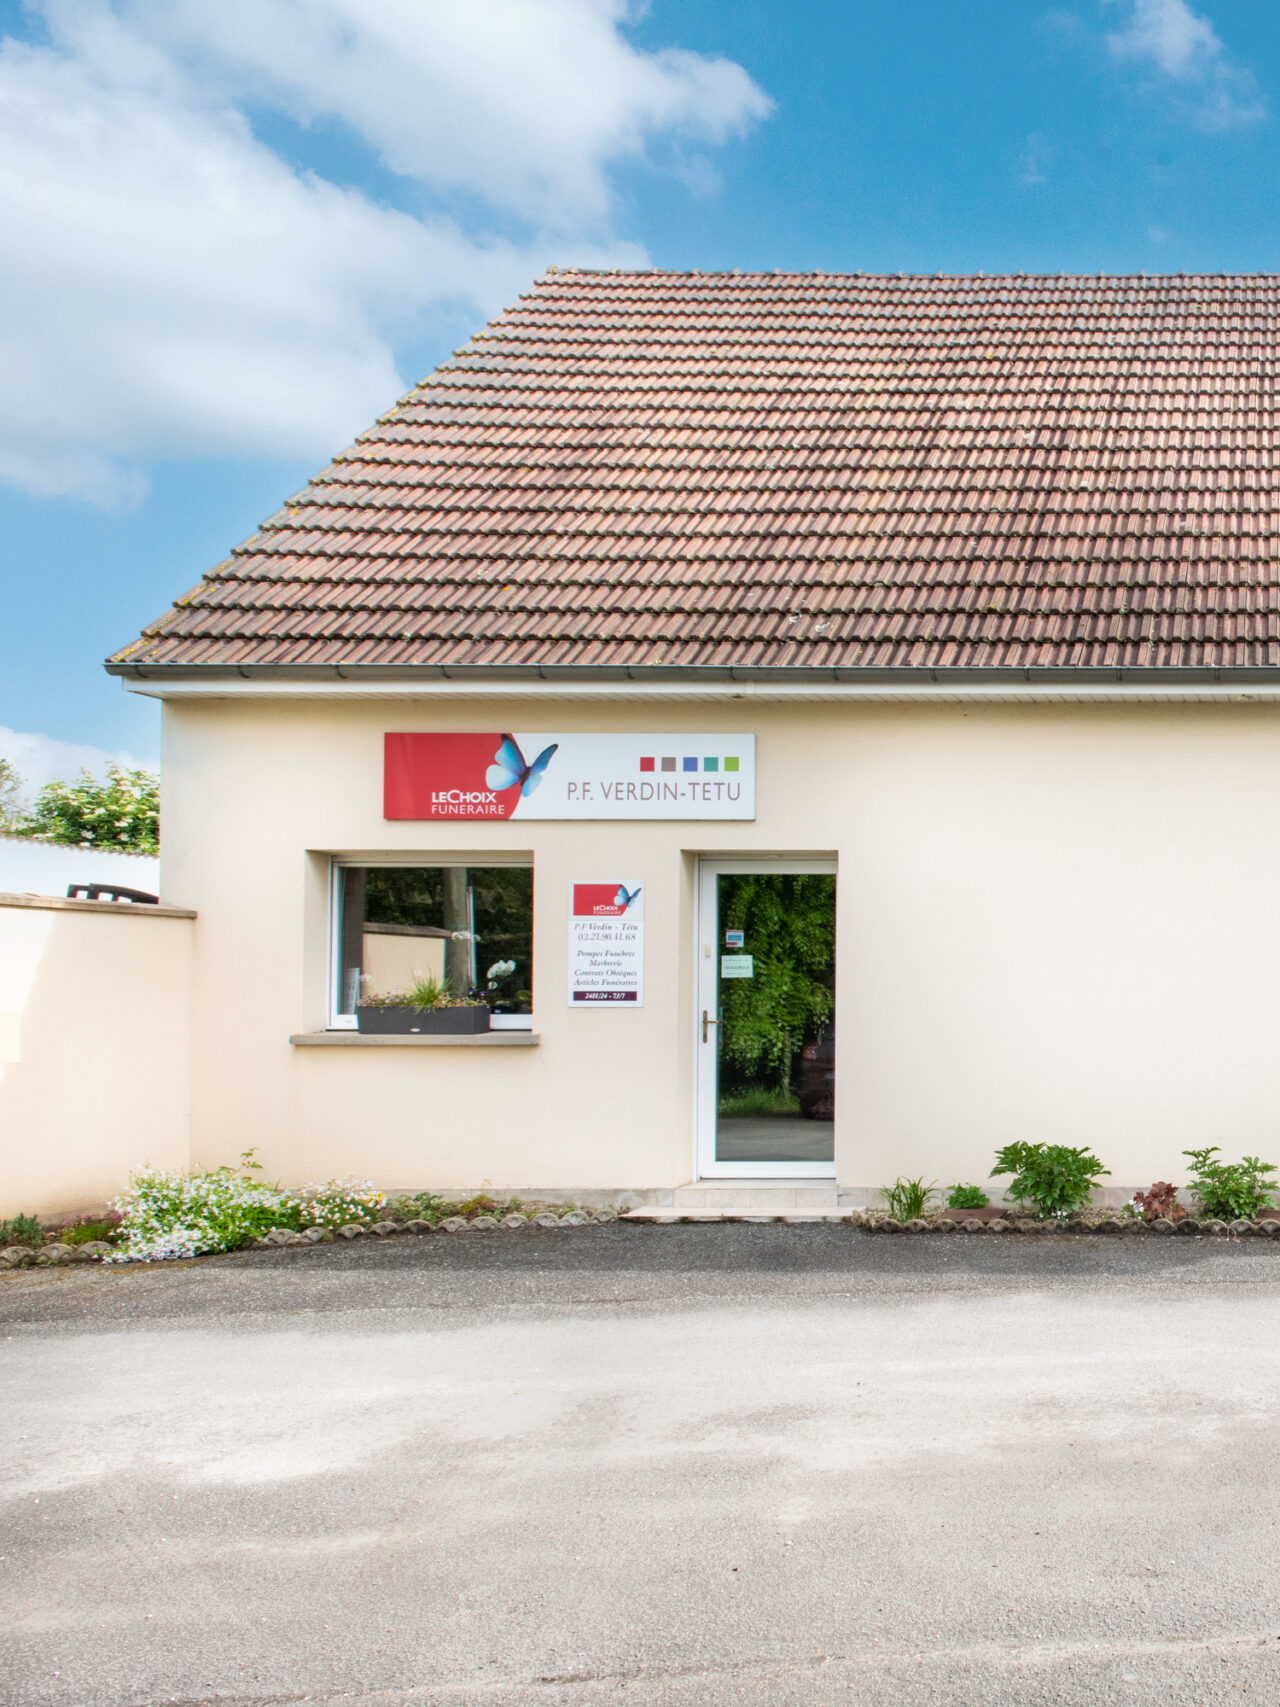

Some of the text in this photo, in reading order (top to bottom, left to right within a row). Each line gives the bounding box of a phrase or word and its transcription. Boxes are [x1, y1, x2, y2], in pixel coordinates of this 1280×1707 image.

[566, 782, 741, 801] P.F. VERDIN-TETU
[431, 804, 505, 815] FUNERAIRE
[589, 923, 613, 931] Verdin
[577, 950, 603, 958] Pompes
